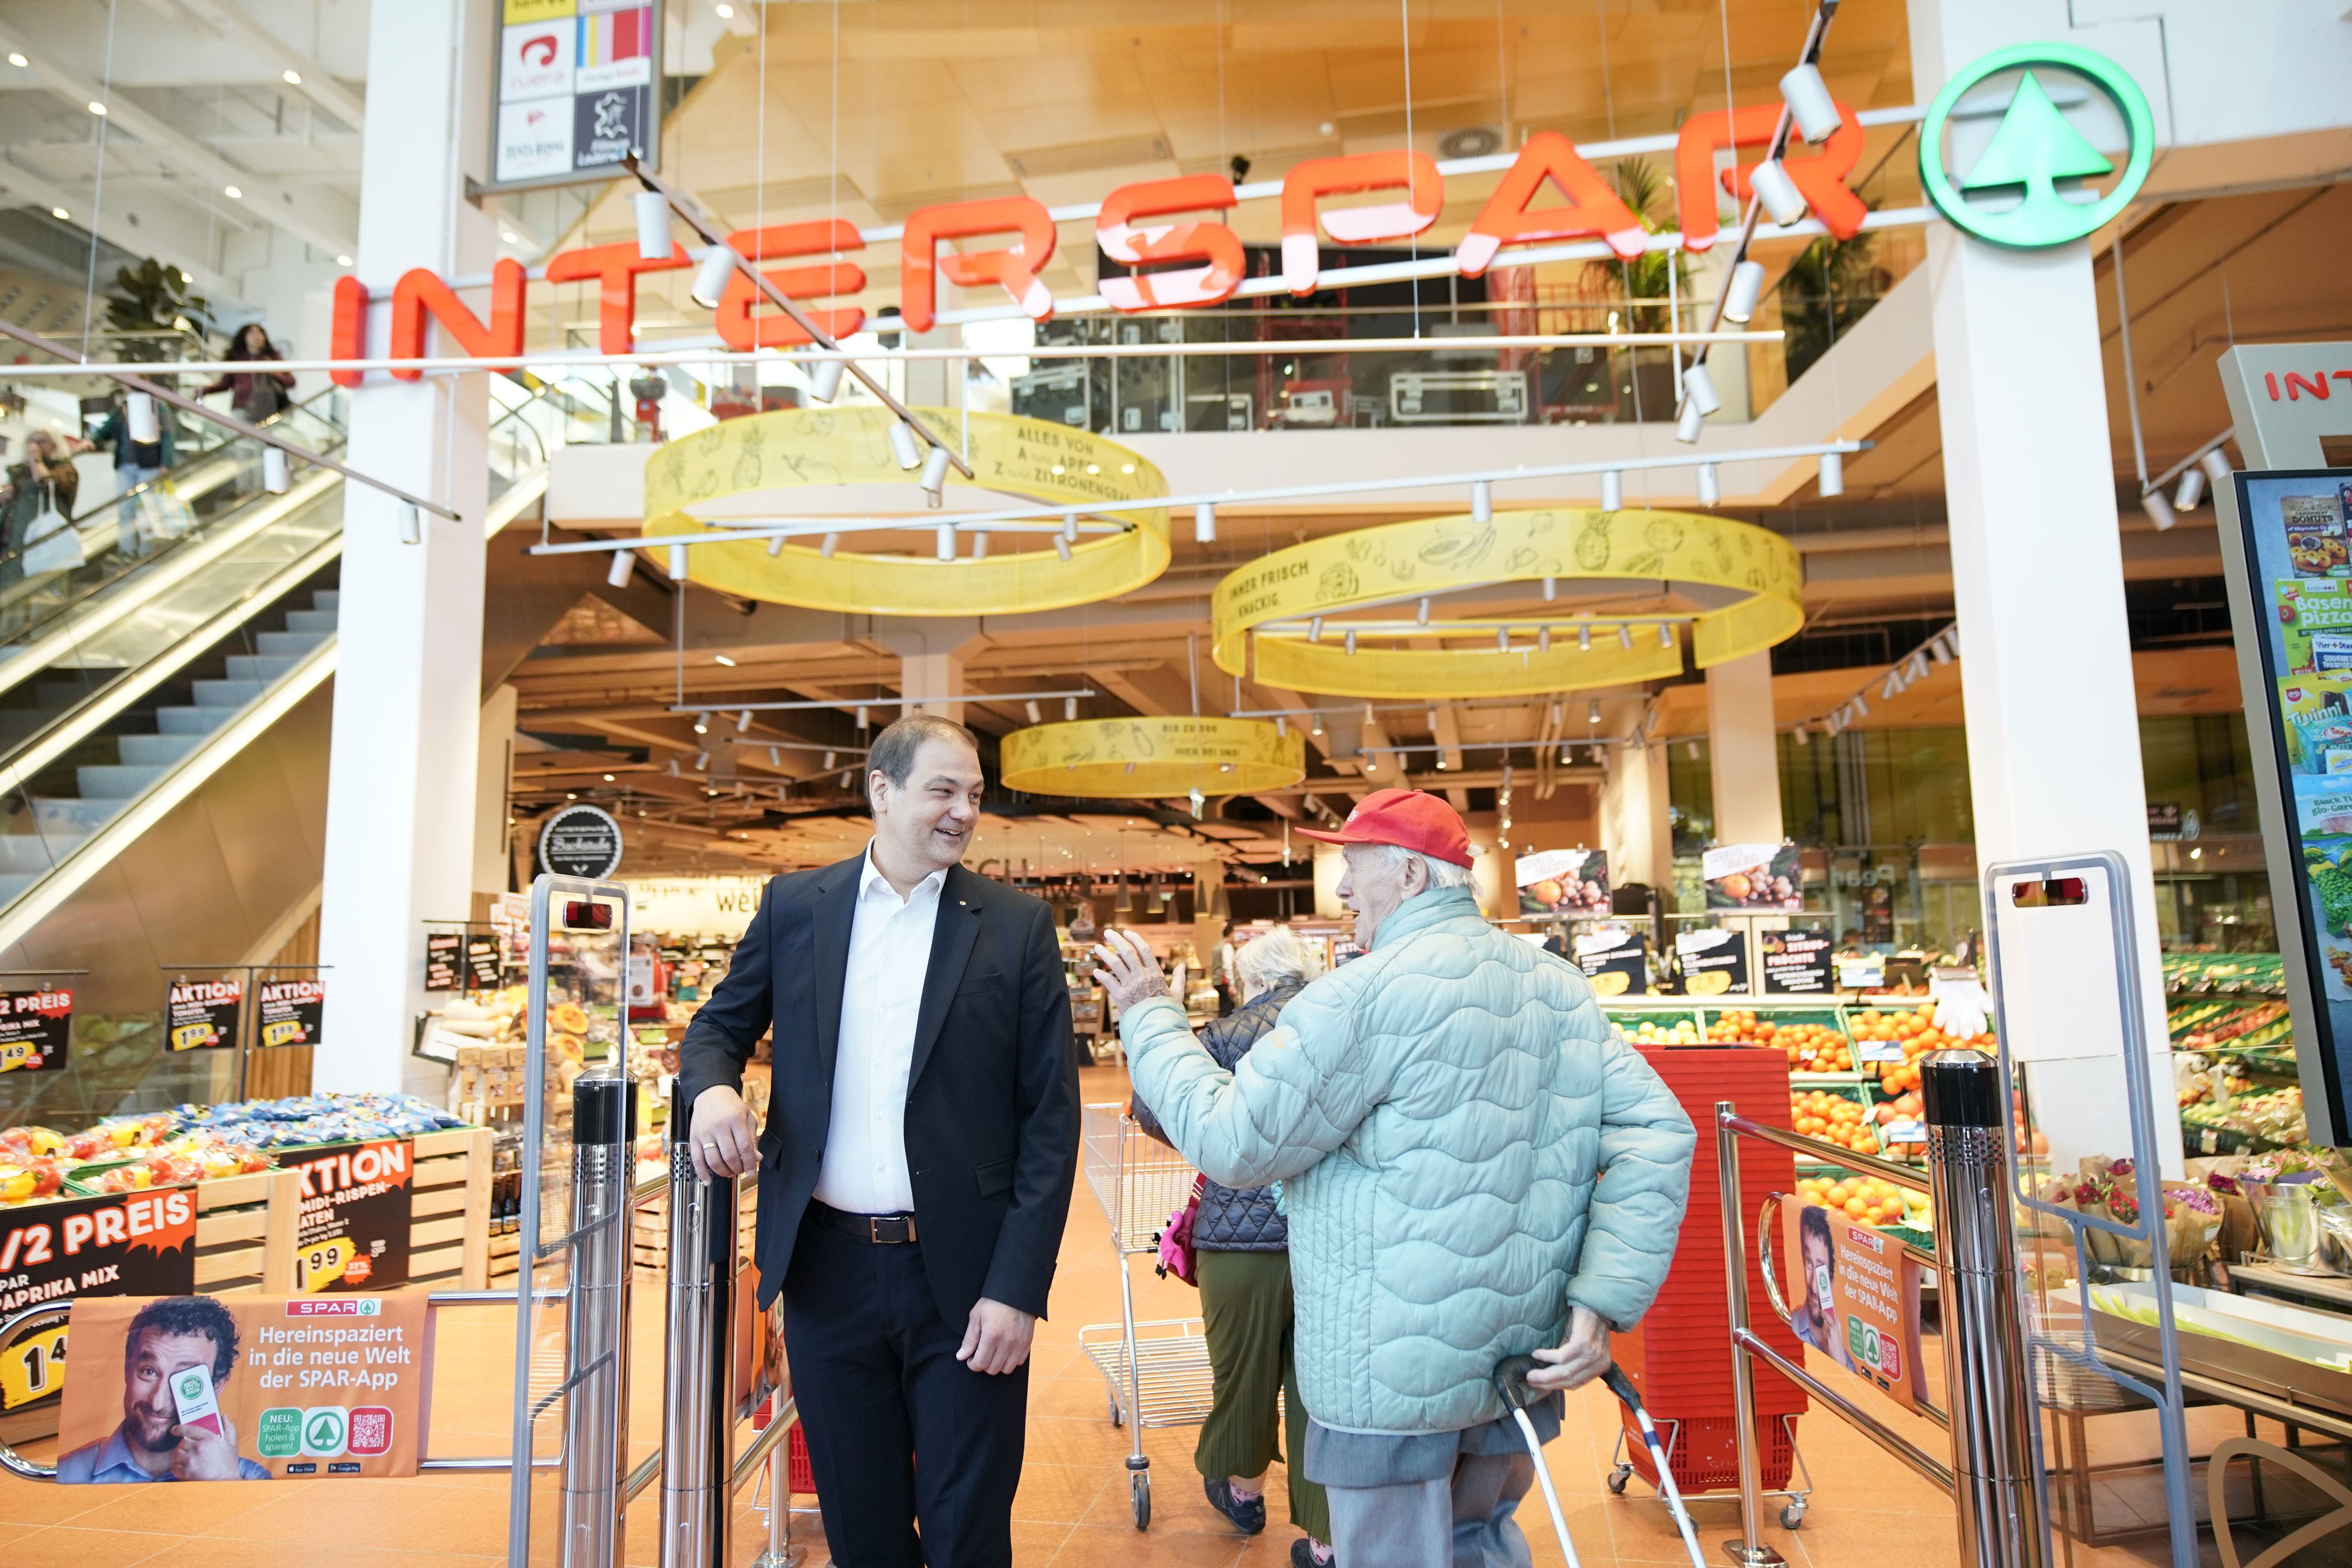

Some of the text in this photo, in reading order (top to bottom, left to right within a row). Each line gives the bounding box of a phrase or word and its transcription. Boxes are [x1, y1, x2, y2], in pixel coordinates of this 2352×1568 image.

[330, 100, 1867, 386] INTERSPAR
[1018, 427, 1093, 456] ALLES VON
[1261, 560, 1309, 586] FRISCH
[2295, 597, 2352, 611] Basen
[2301, 611, 2352, 627] pizza
[2287, 701, 2343, 724] Twinni
[2314, 798, 2341, 806] Black
[1767, 952, 1816, 967] FRÜCHTE
[15, 992, 71, 1013] PREIS
[171, 982, 240, 1004] AKTION
[261, 982, 323, 1002] AKTION
[294, 1144, 406, 1198] KTION
[64, 1193, 191, 1256] PREIS
[1852, 1231, 1873, 1246] SPAR
[1840, 1244, 1894, 1283] Hereinspaziert
[0, 1264, 120, 1311] APRIKA MIX
[1839, 1261, 1899, 1305] in die neue Welt
[300, 1302, 356, 1314] SPAR
[1844, 1282, 1898, 1324] der SPAR-App
[259, 1324, 403, 1347] Hereinspaziert
[249, 1345, 411, 1366] in die neue Welt
[259, 1369, 399, 1391] der SPAR-App
[262, 1423, 300, 1433] SPAR-App
[270, 1414, 293, 1423] NEU:
[265, 1442, 293, 1452] sparen!
[266, 1432, 295, 1441] holen &
